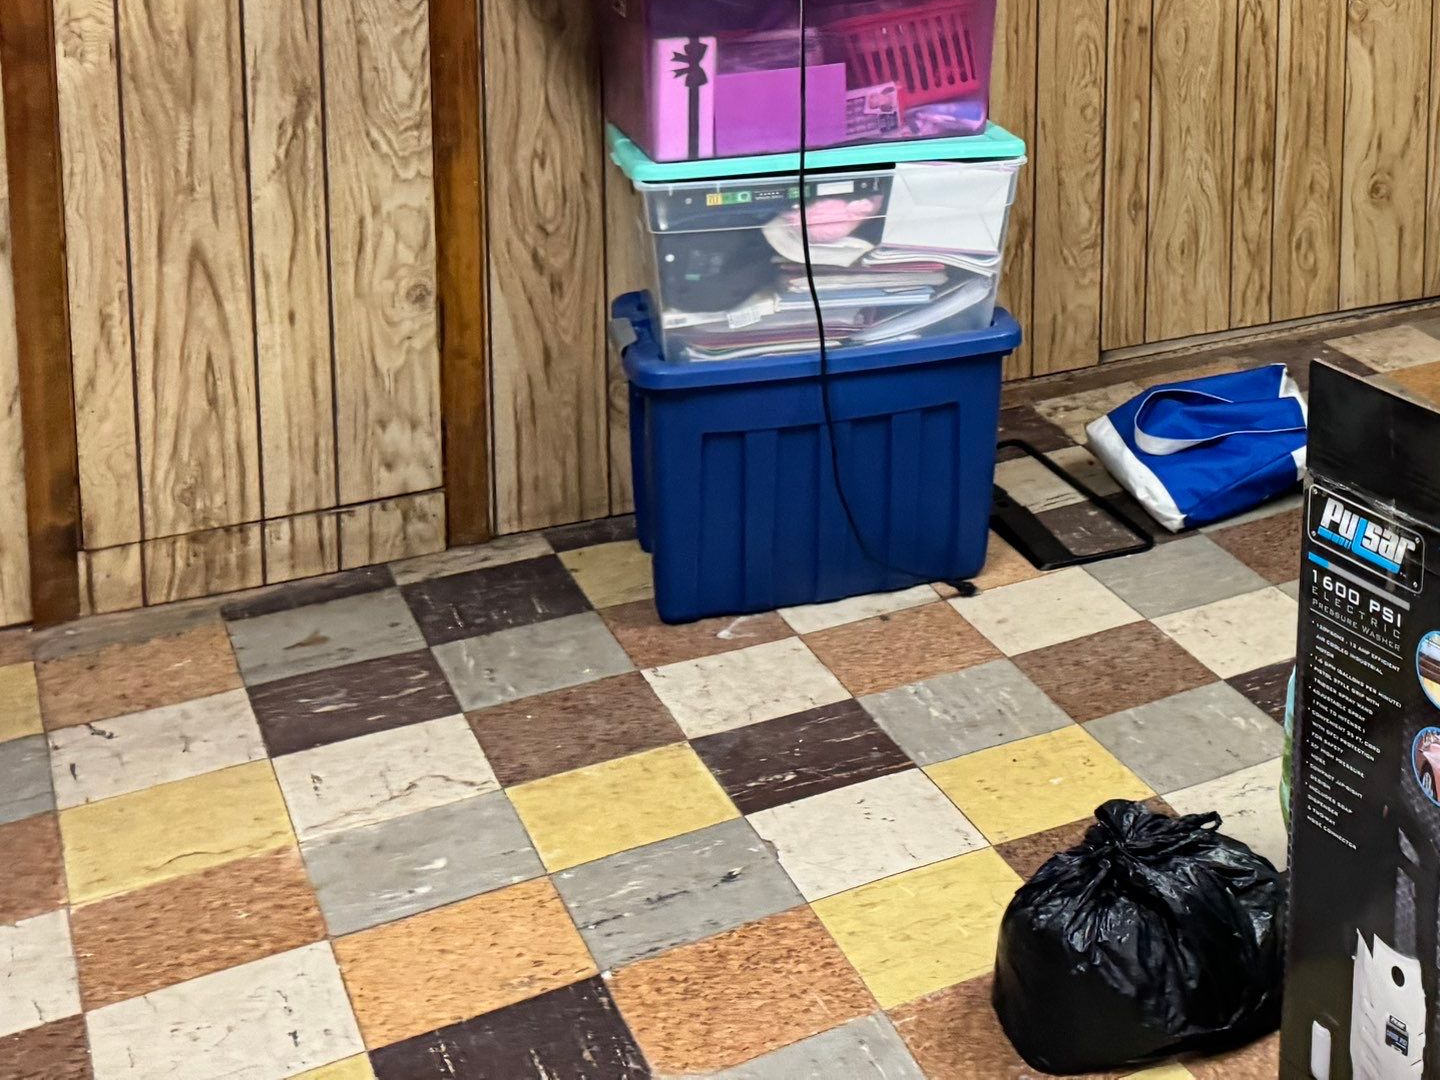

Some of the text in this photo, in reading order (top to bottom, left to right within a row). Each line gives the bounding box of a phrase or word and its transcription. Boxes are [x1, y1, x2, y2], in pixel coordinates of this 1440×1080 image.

[1312, 569, 1401, 628] 1600 PSI
[1312, 585, 1400, 639] ELECTRIC
[1312, 597, 1400, 652] PRESSURE WASHER
[1349, 653, 1384, 675] INDUSTRIAL
[1371, 653, 1400, 672] EFFICIENT
[1312, 688, 1366, 721] ADJUSTABLE SPRAY
[1313, 666, 1332, 680] PISTOL
[1333, 677, 1350, 691] STYLE
[1365, 696, 1380, 707] WITH
[1314, 677, 1374, 716] TRIGGER SPRAY WAND
[1311, 709, 1346, 733] CONVENIENT
[1364, 741, 1381, 753] CORD
[1311, 732, 1344, 753] FOR SAFETY
[1312, 721, 1325, 731] WITH
[1340, 738, 1375, 761] PROTECTION
[1335, 757, 1365, 778] PRESSURE
